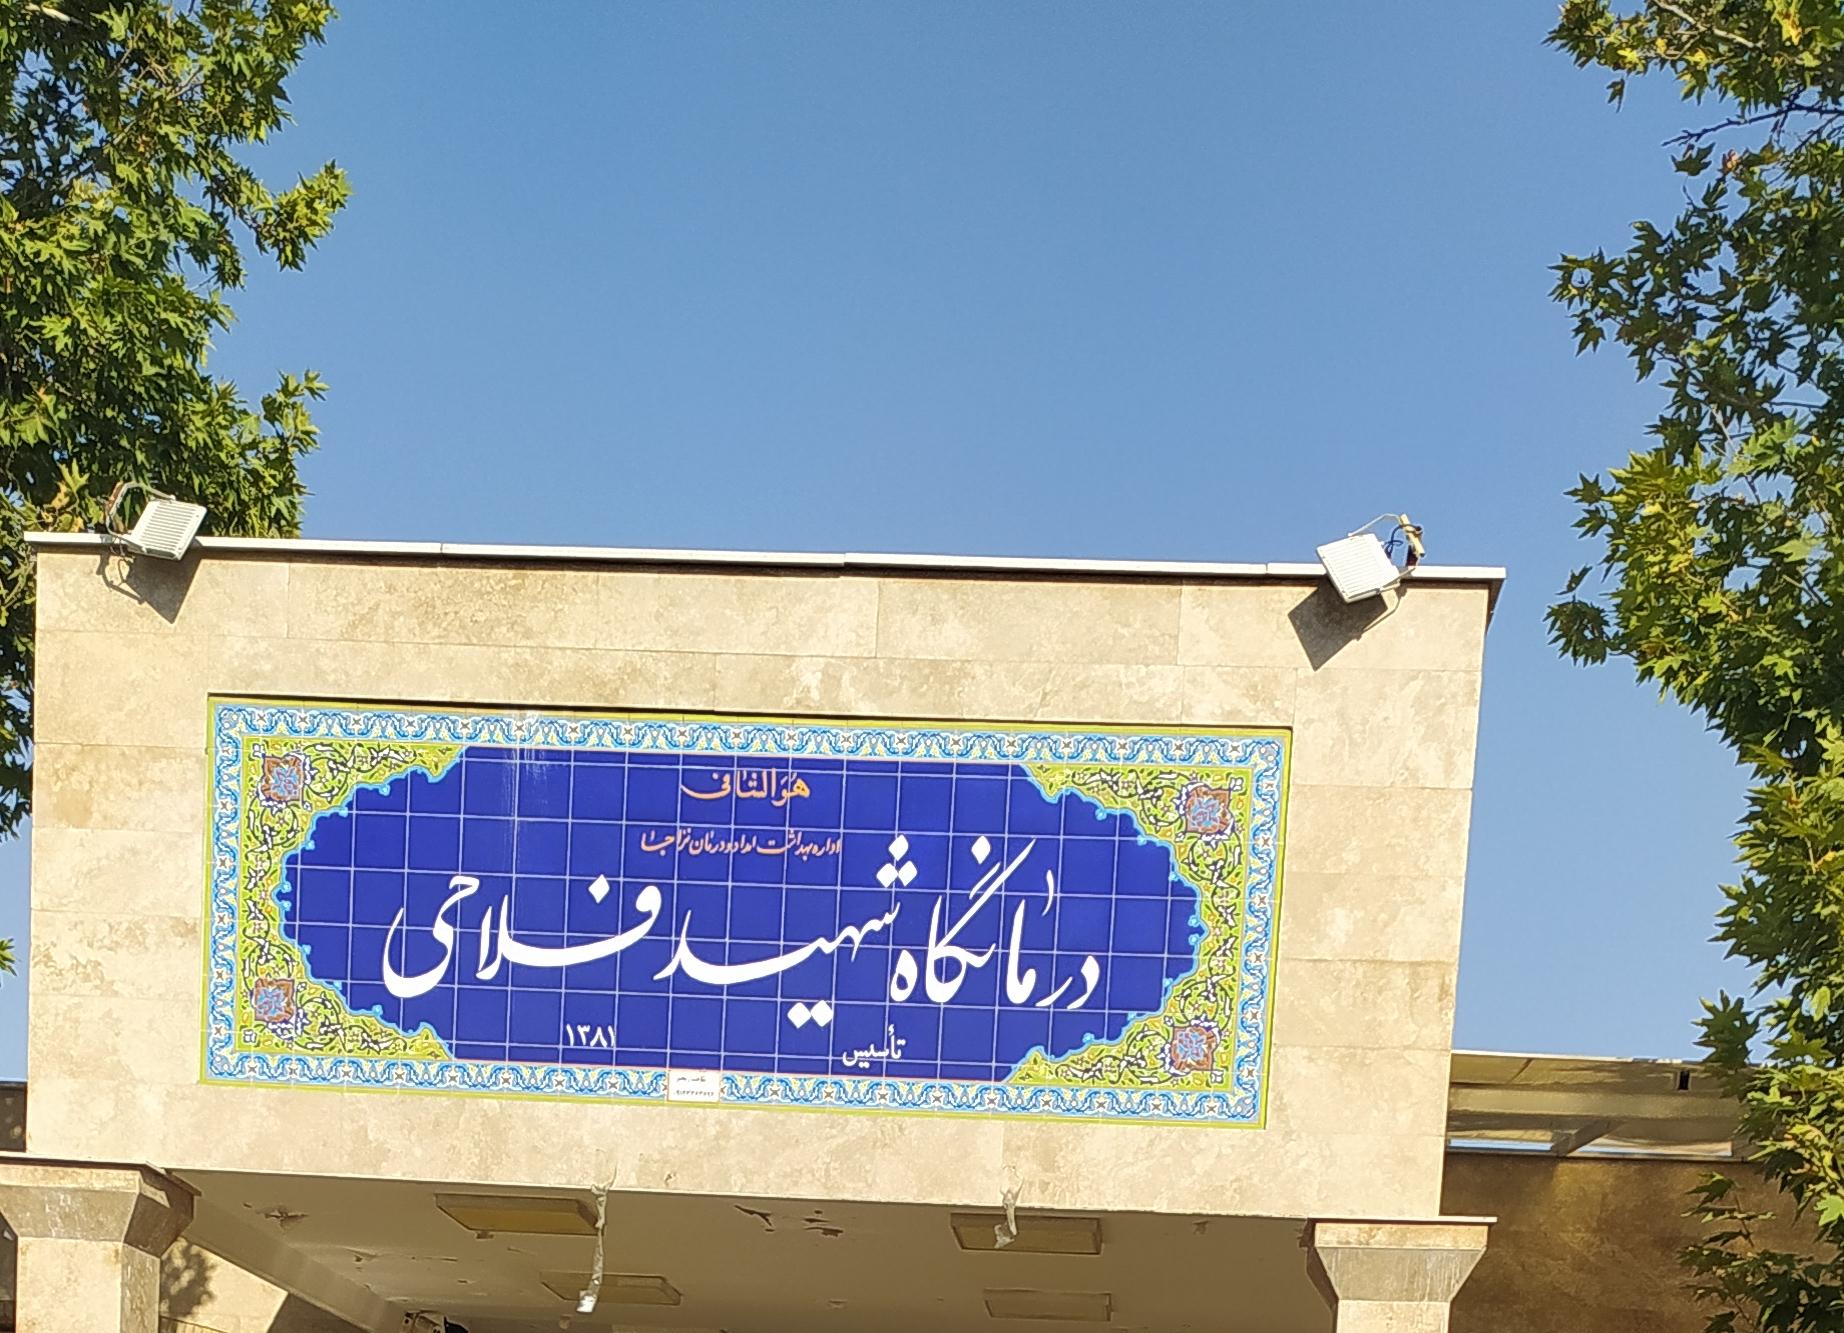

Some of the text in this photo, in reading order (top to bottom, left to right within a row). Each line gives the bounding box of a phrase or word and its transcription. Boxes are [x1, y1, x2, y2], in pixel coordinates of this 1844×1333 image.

[382, 834, 1100, 1029] درمانگاه شهید فلاحی
[564, 1023, 617, 1049] ۱۳۸۱
